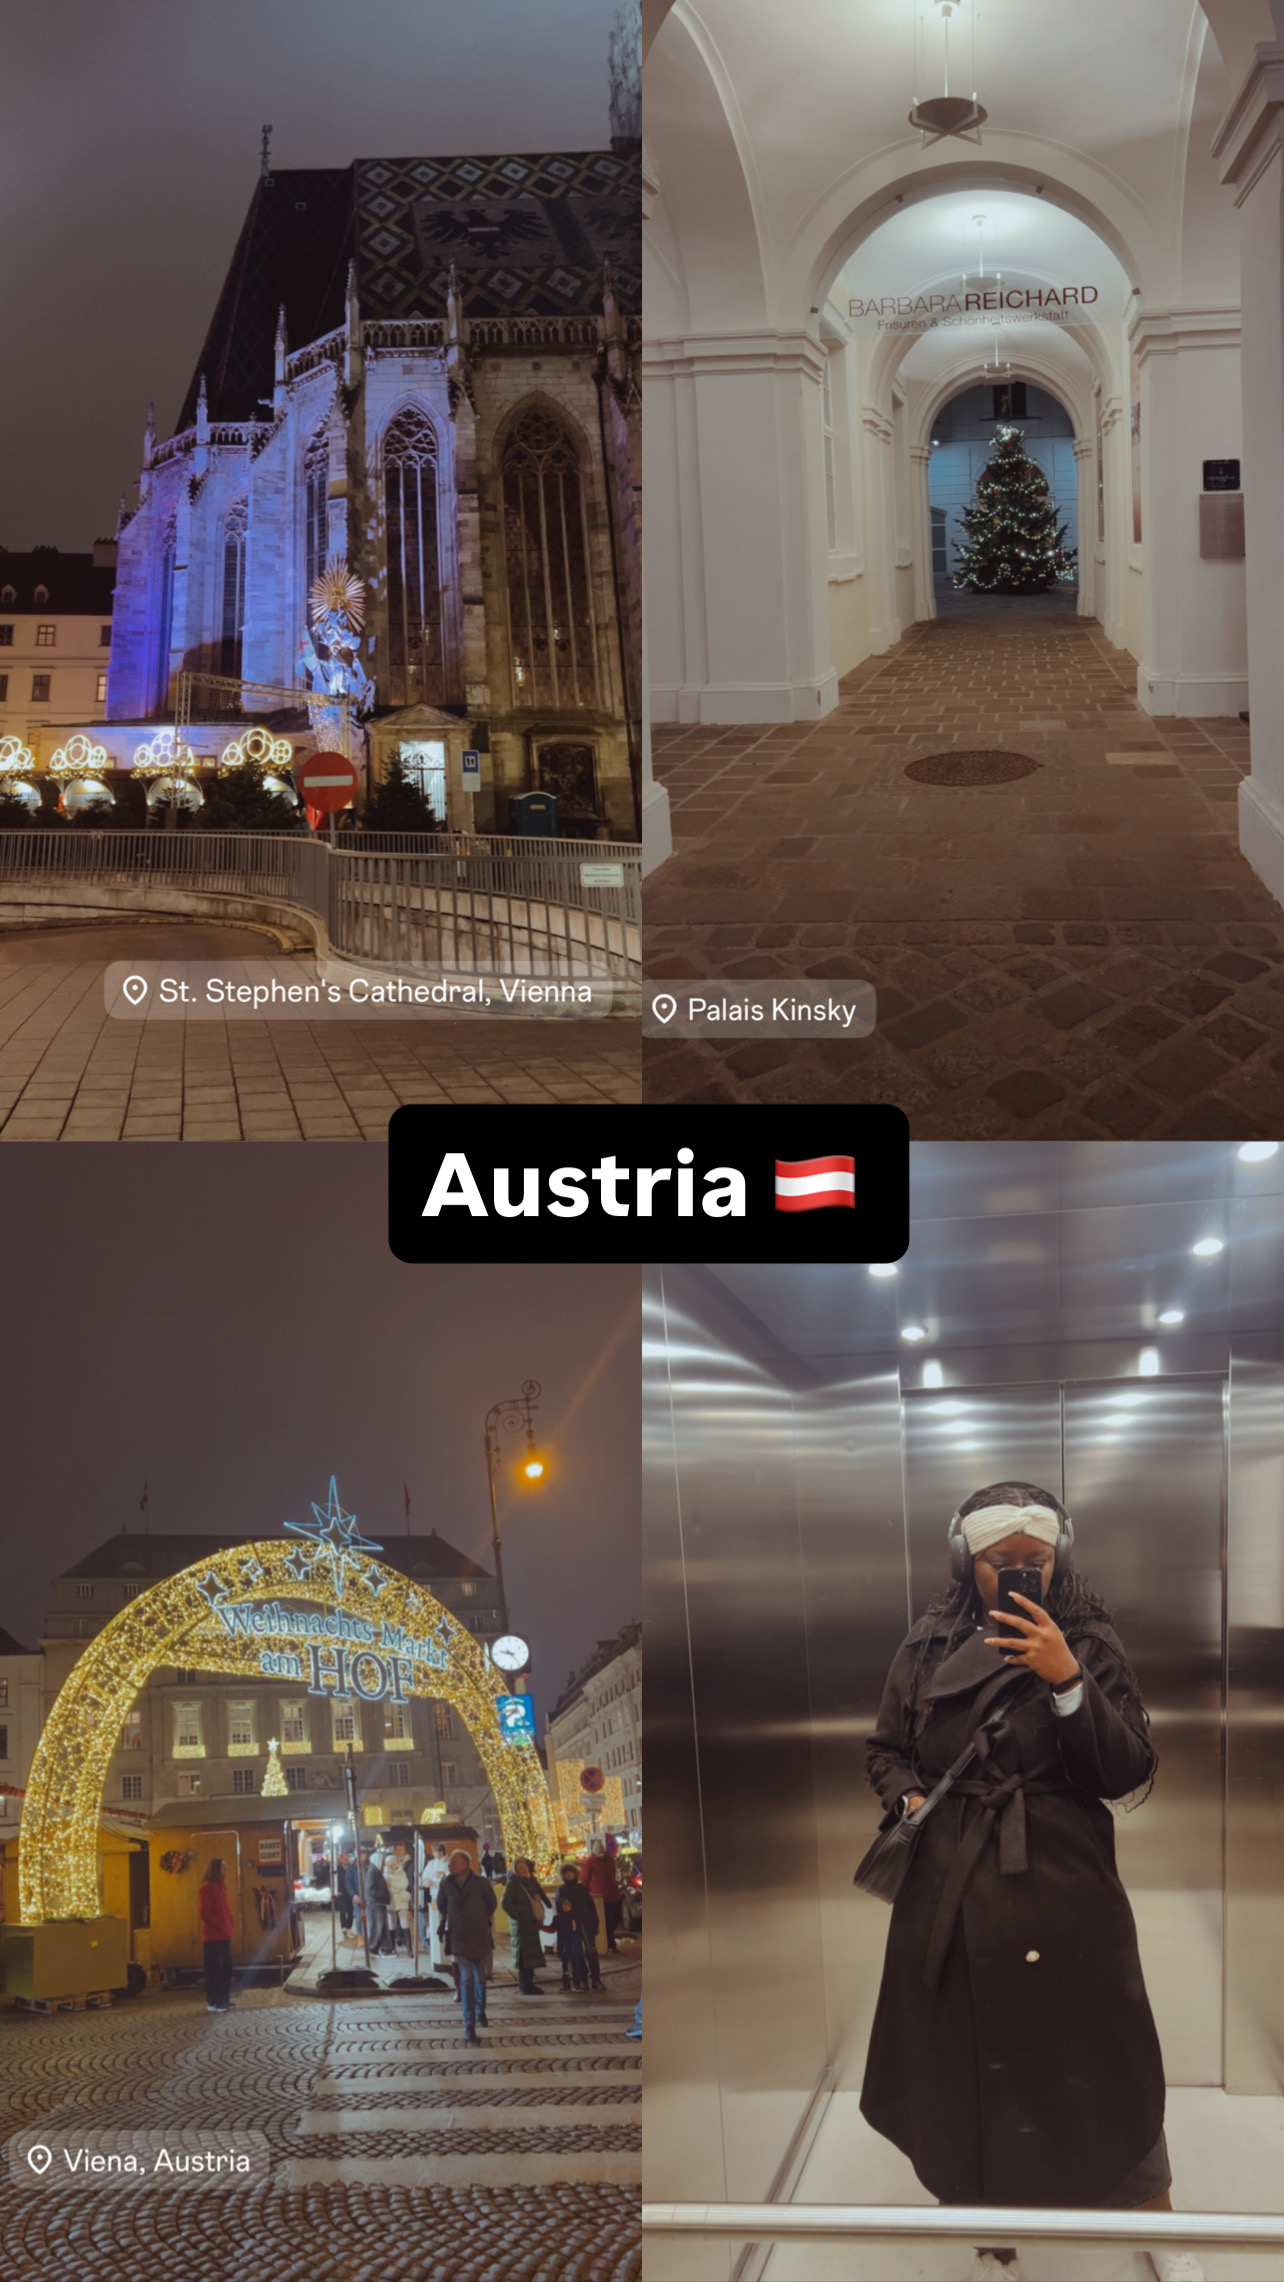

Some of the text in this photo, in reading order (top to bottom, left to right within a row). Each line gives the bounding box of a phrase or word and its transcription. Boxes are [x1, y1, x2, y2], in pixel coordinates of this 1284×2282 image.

[848, 285, 1099, 318] BARBARA REICHARD
[877, 317, 927, 331] Frisuren
[929, 317, 939, 328] &
[213, 1601, 449, 1671] Weihnachts Markt
[260, 1642, 415, 1704] am HOF
